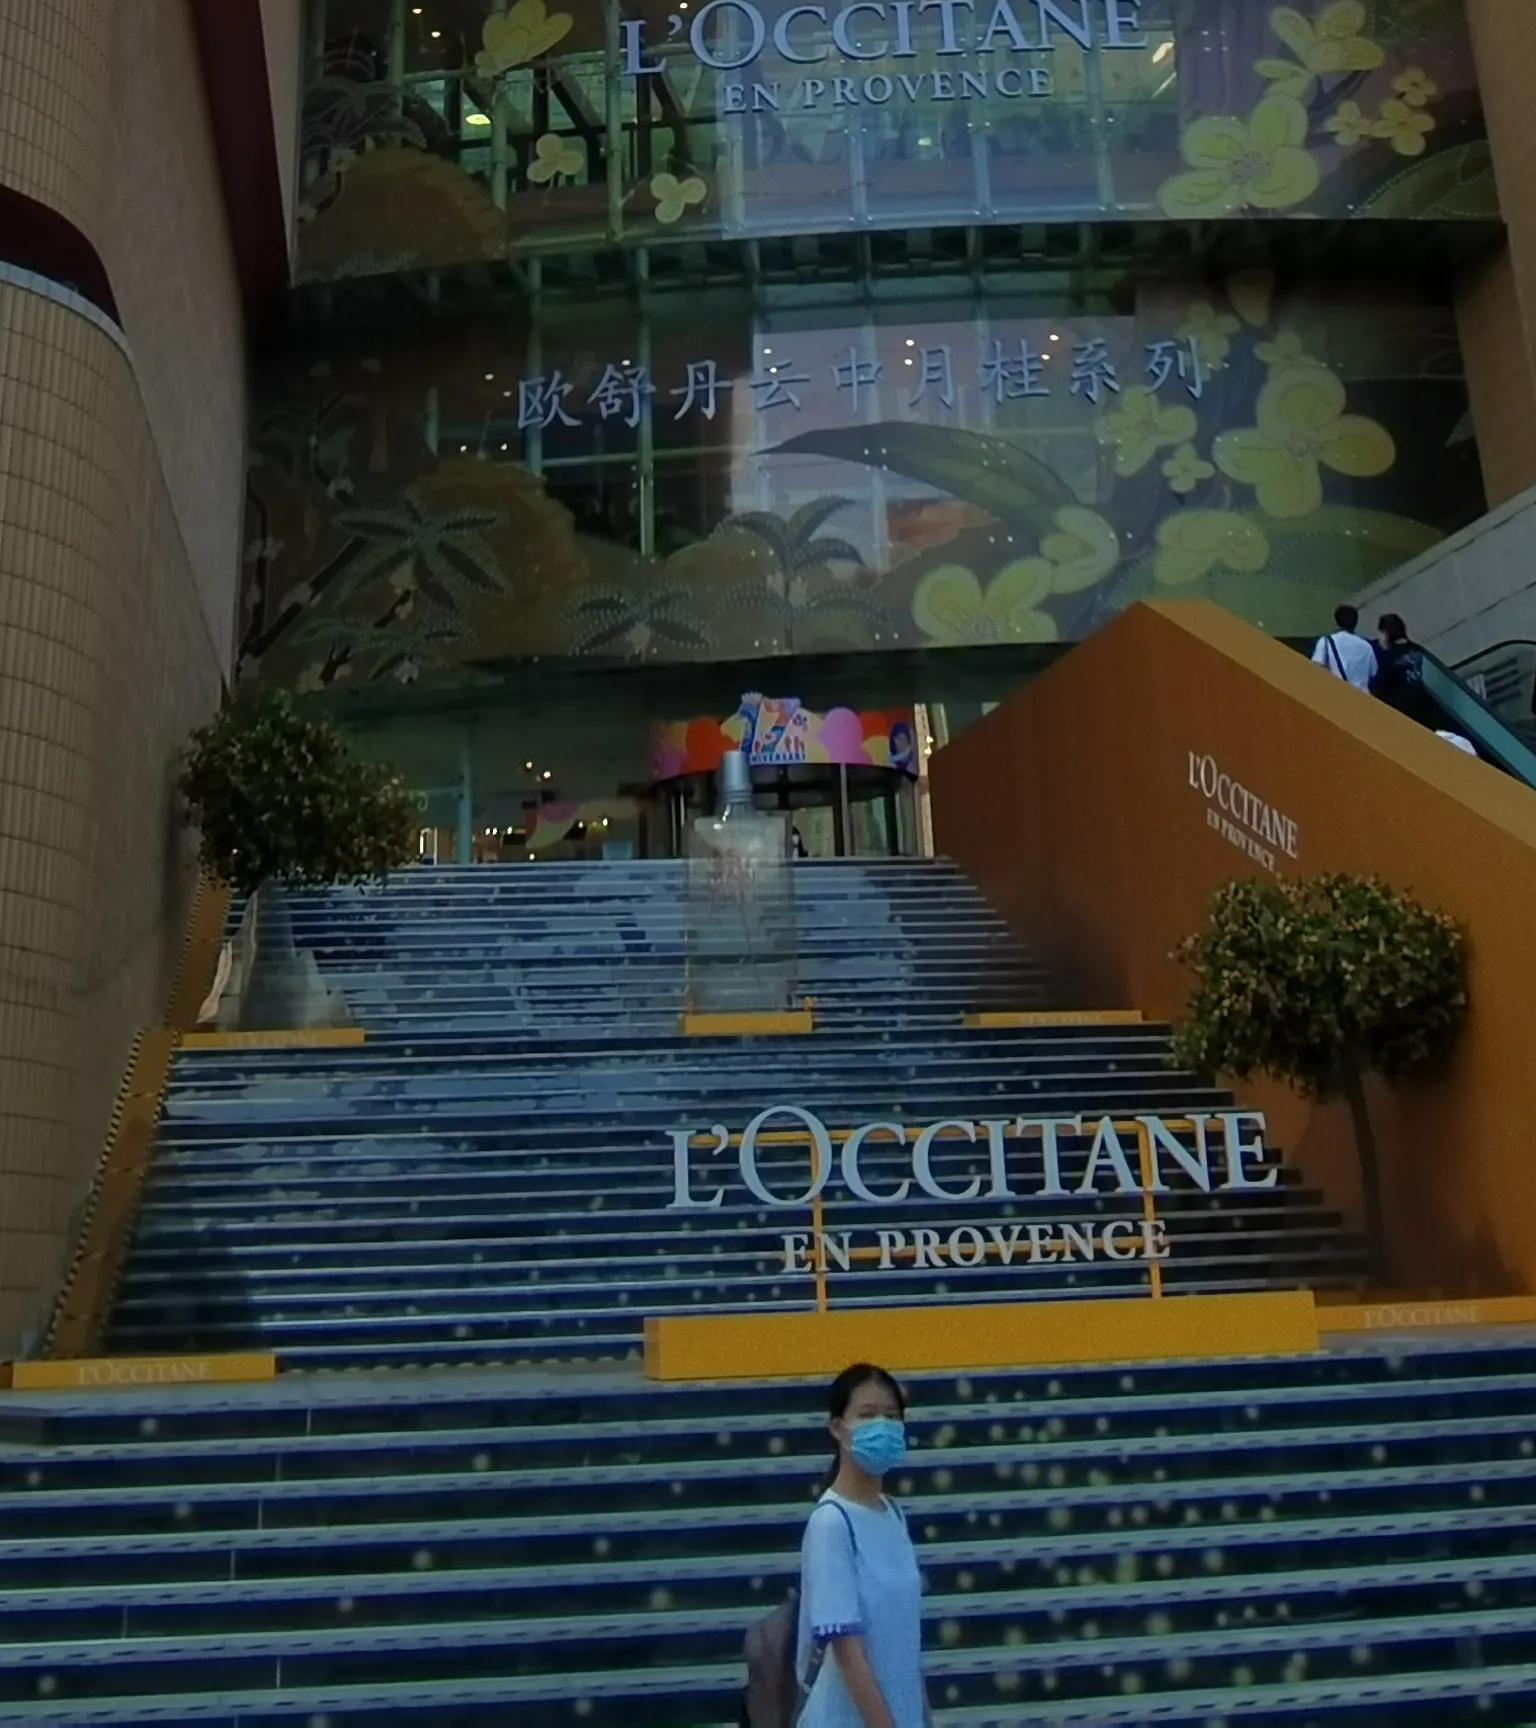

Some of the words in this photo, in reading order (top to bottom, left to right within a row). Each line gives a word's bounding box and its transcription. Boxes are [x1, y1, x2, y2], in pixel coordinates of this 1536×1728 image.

[722, 82, 781, 115] EN
[800, 68, 1055, 109] PROVENCE
[516, 333, 1204, 431] 欧舒丹云中月桂系列
[664, 1104, 1279, 1210] L'OCCITANE
[781, 1230, 856, 1274] EN
[875, 1218, 1173, 1271] PROVENCE
